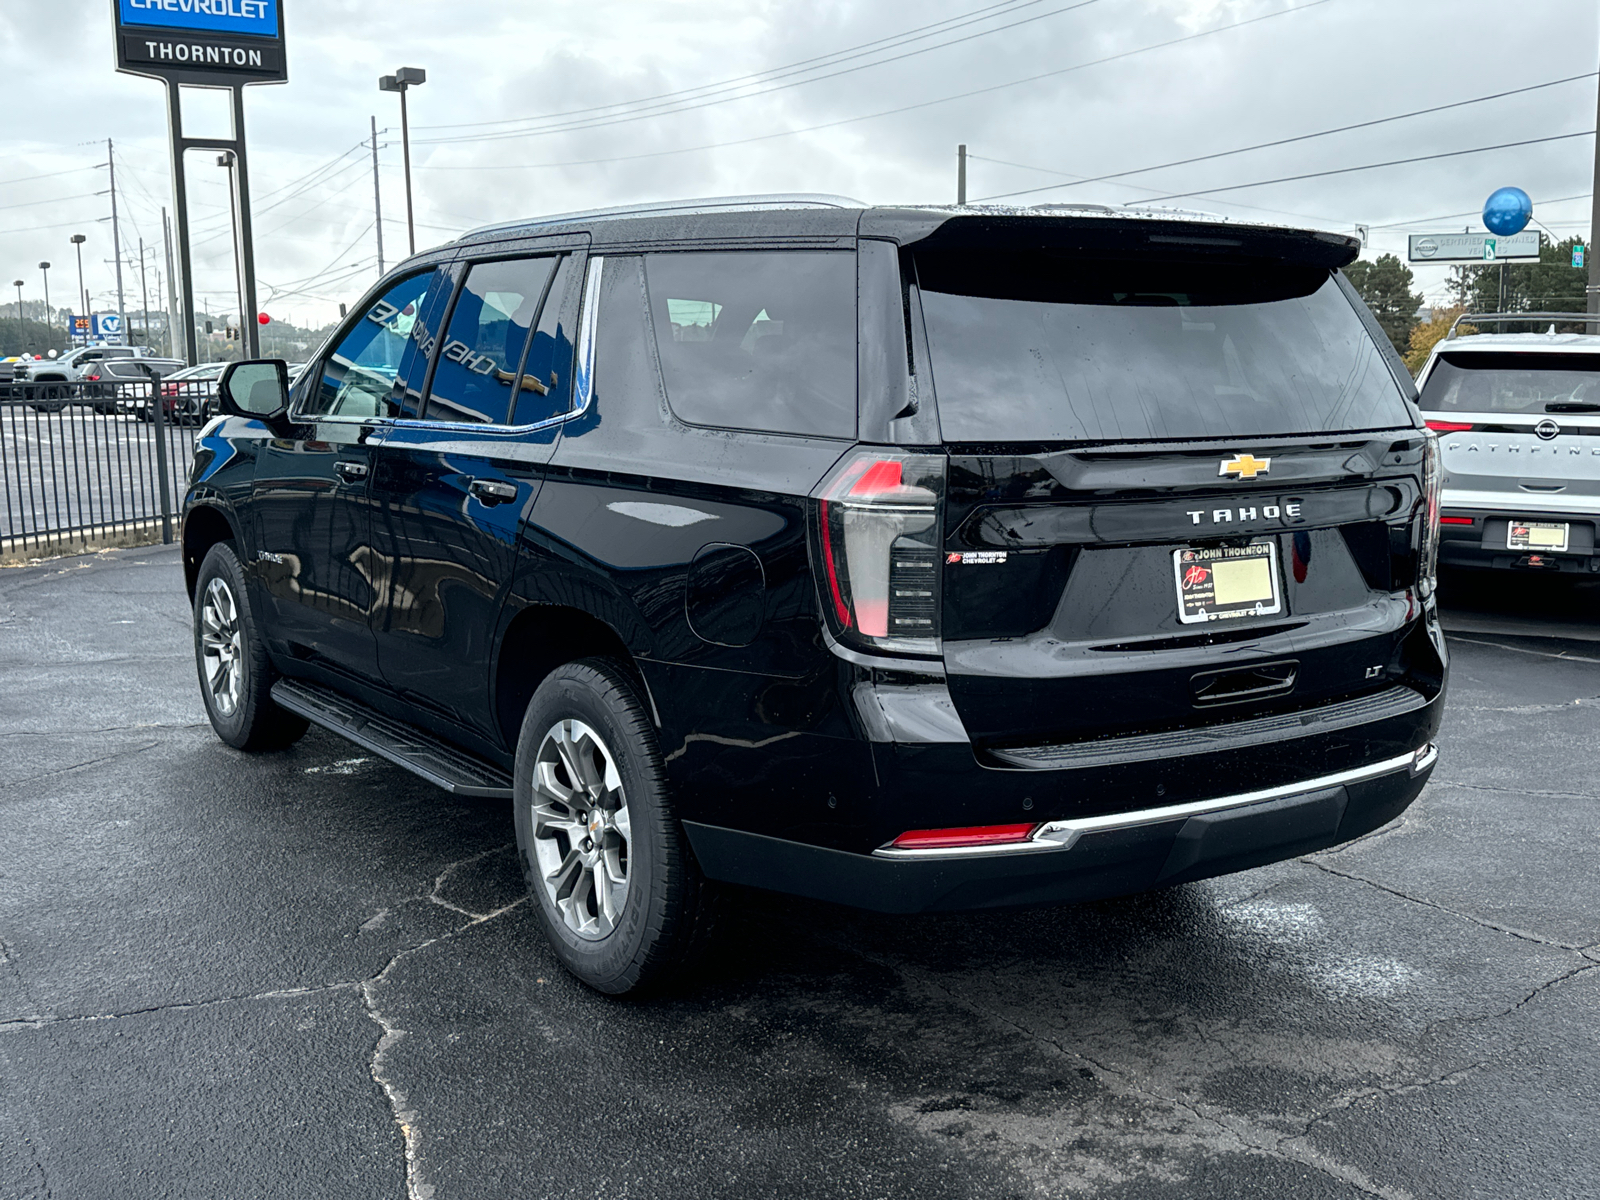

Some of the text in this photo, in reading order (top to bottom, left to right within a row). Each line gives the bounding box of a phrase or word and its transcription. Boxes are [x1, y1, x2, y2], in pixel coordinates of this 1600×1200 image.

[145, 41, 262, 66] THORNTON
[1441, 238, 1483, 247] CERTIFIED
[1186, 504, 1301, 525] TAHOE
[1199, 549, 1222, 560] JOHN
[1365, 665, 1383, 679] LT
